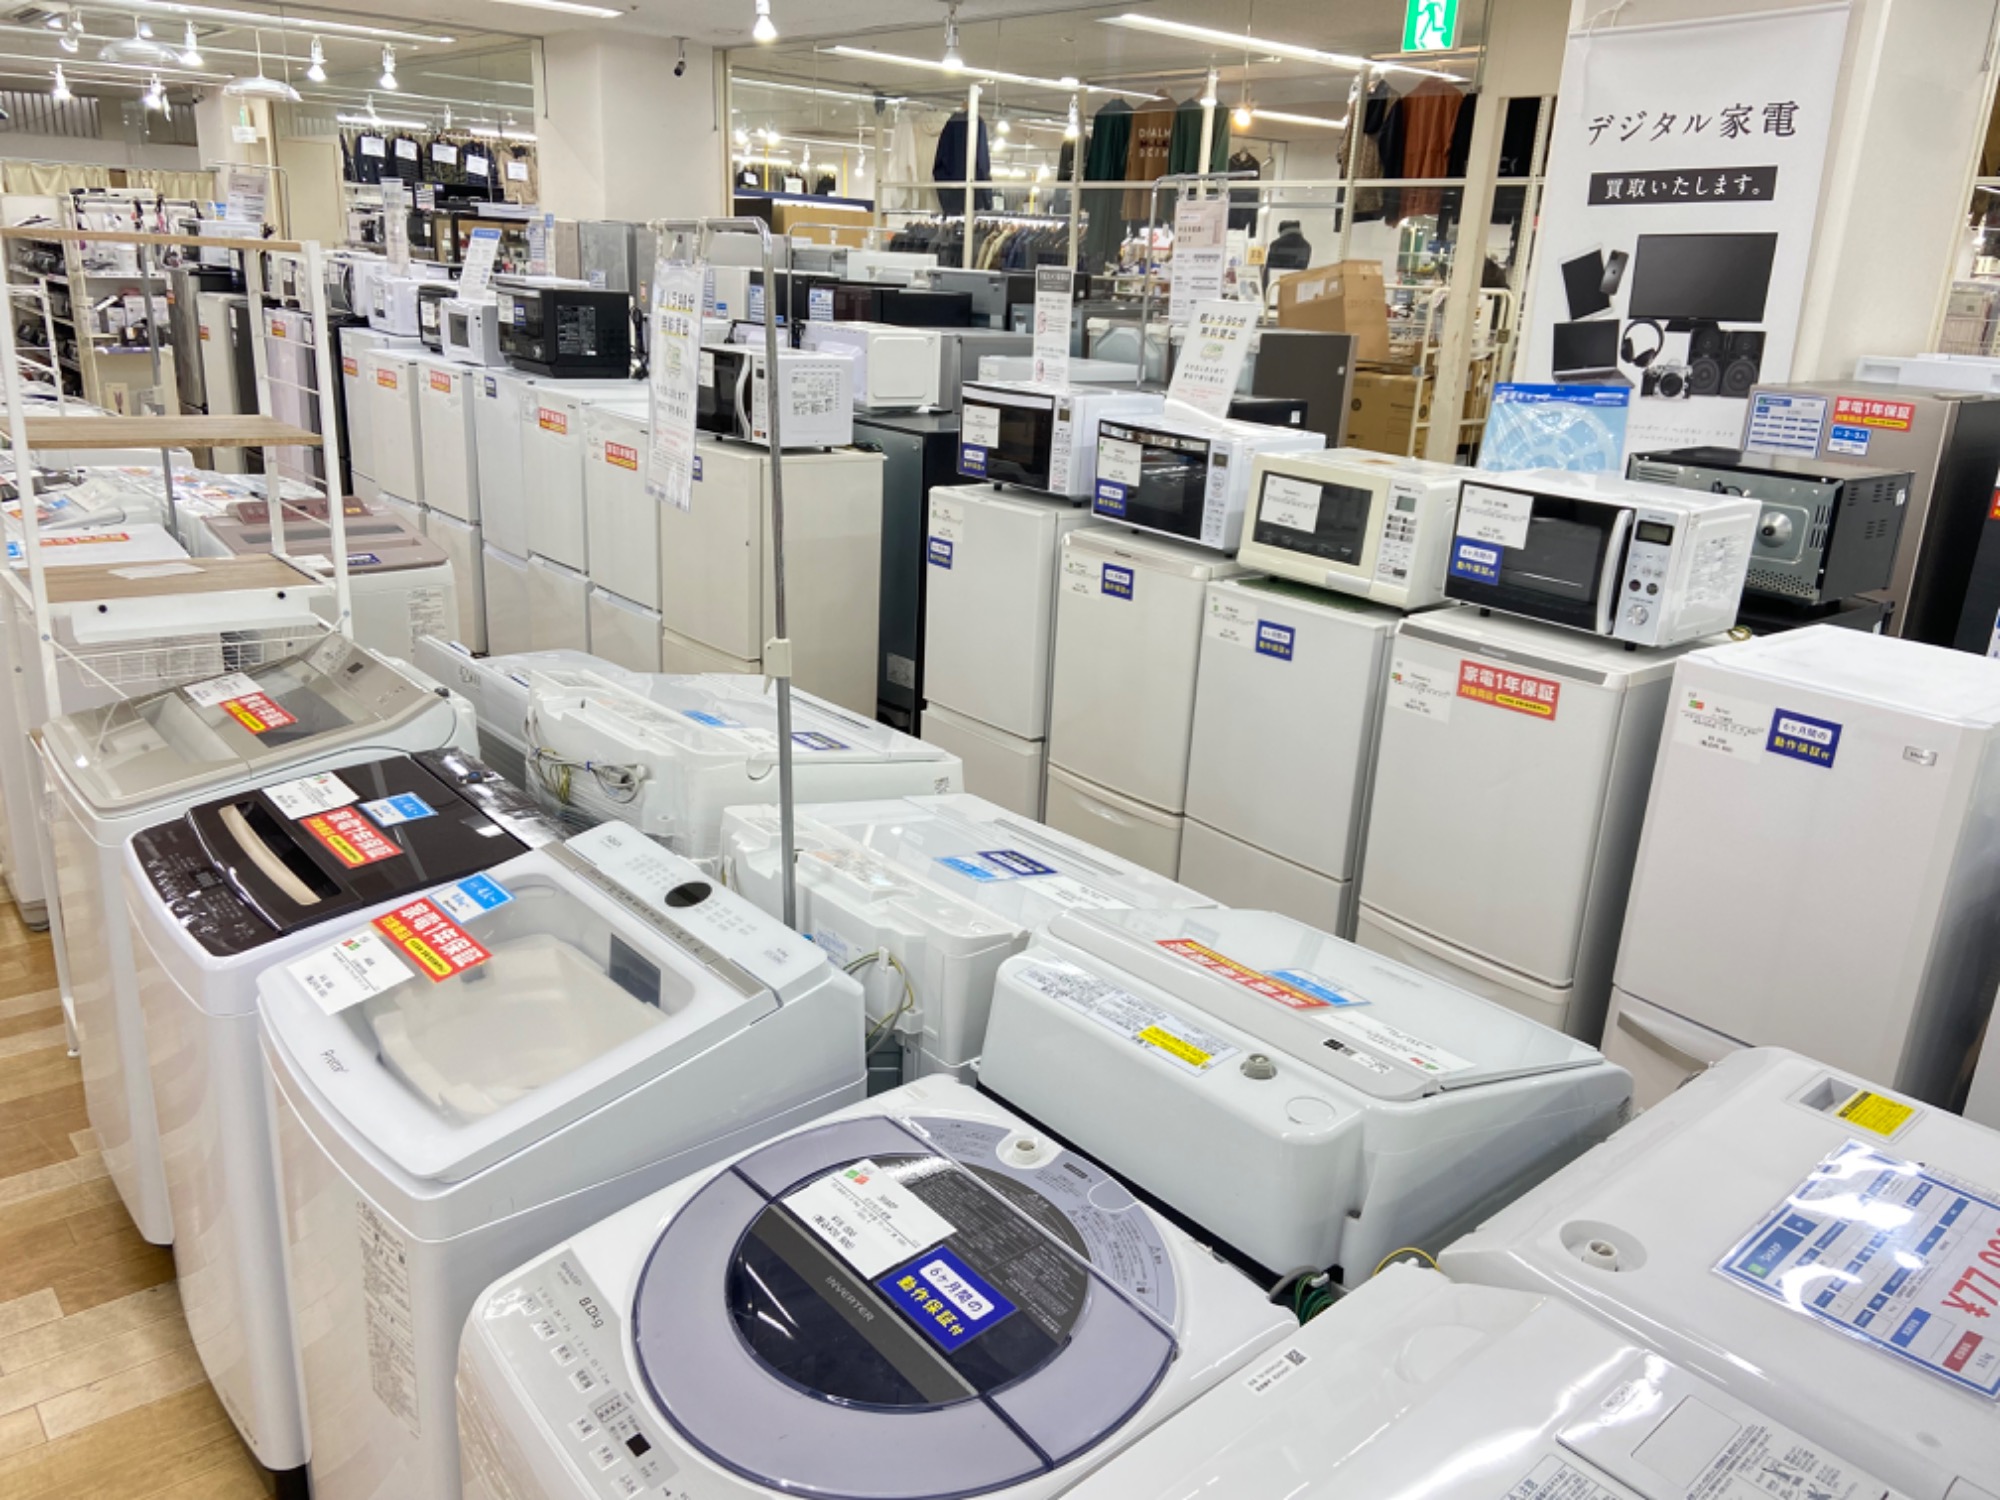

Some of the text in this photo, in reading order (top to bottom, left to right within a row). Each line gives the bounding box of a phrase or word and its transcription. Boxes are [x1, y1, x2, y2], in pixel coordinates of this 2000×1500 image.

[1588, 100, 1799, 146] デジタル家電
[1604, 174, 1761, 200] 買取いたします。
[1837, 399, 1911, 420] 家電1年保証
[1463, 666, 1555, 703] 家電1年保証
[400, 901, 485, 968] 家電1年保証
[824, 1275, 875, 1323] INVERTER
[896, 1275, 965, 1336] 動作保証付
